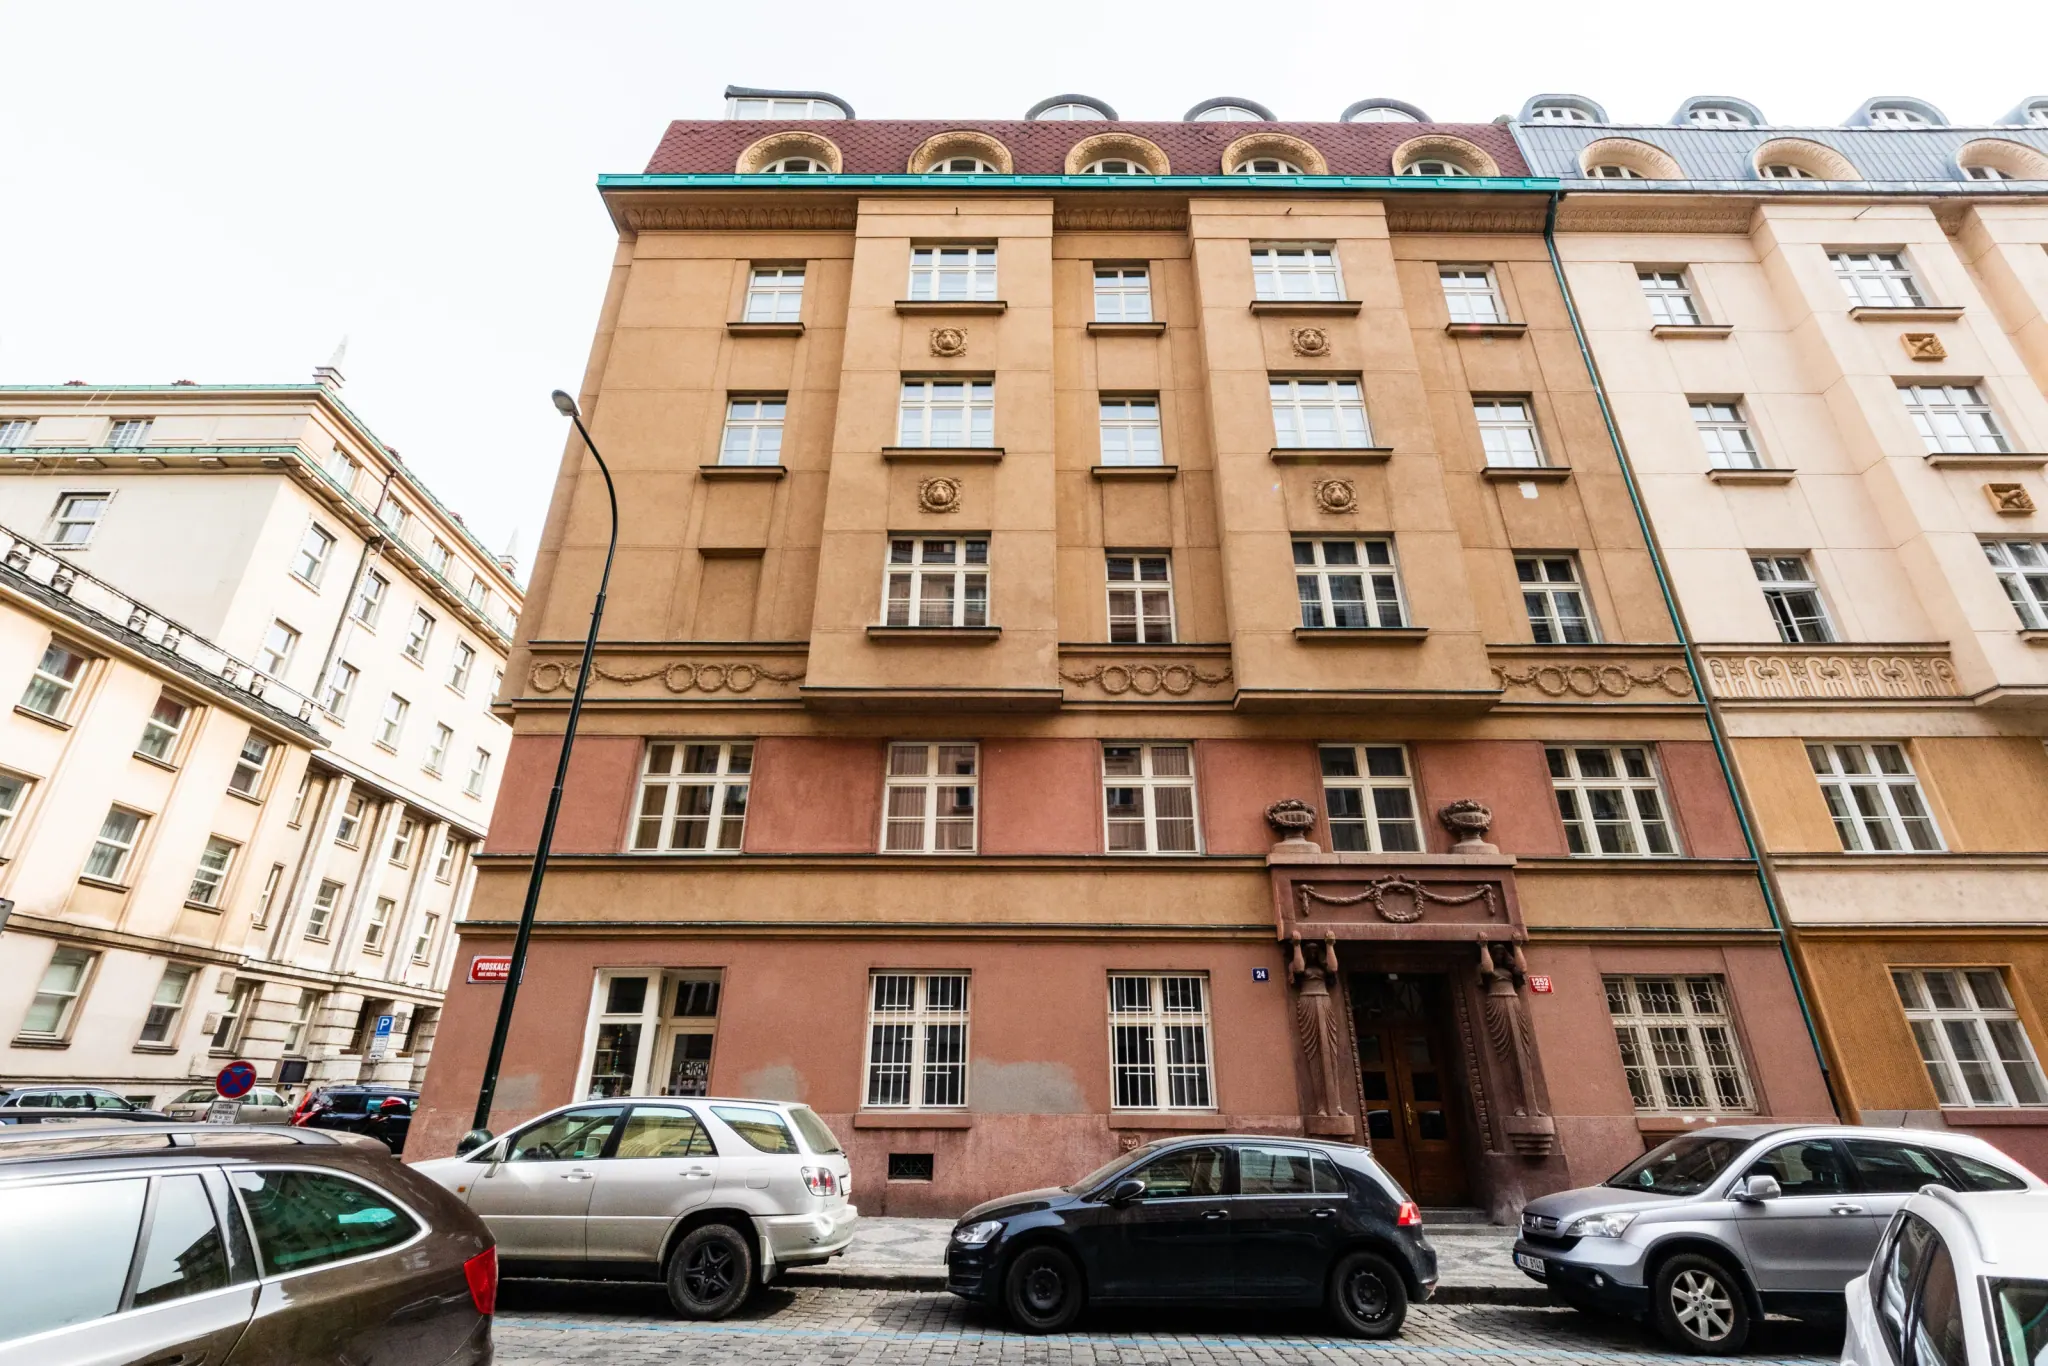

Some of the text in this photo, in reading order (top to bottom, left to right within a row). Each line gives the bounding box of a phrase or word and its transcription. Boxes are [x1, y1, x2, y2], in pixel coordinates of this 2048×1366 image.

[477, 962, 511, 971] PODSKALS
[1256, 970, 1266, 979] 24
[1531, 977, 1549, 986] 1252
[379, 1018, 390, 1031] P
